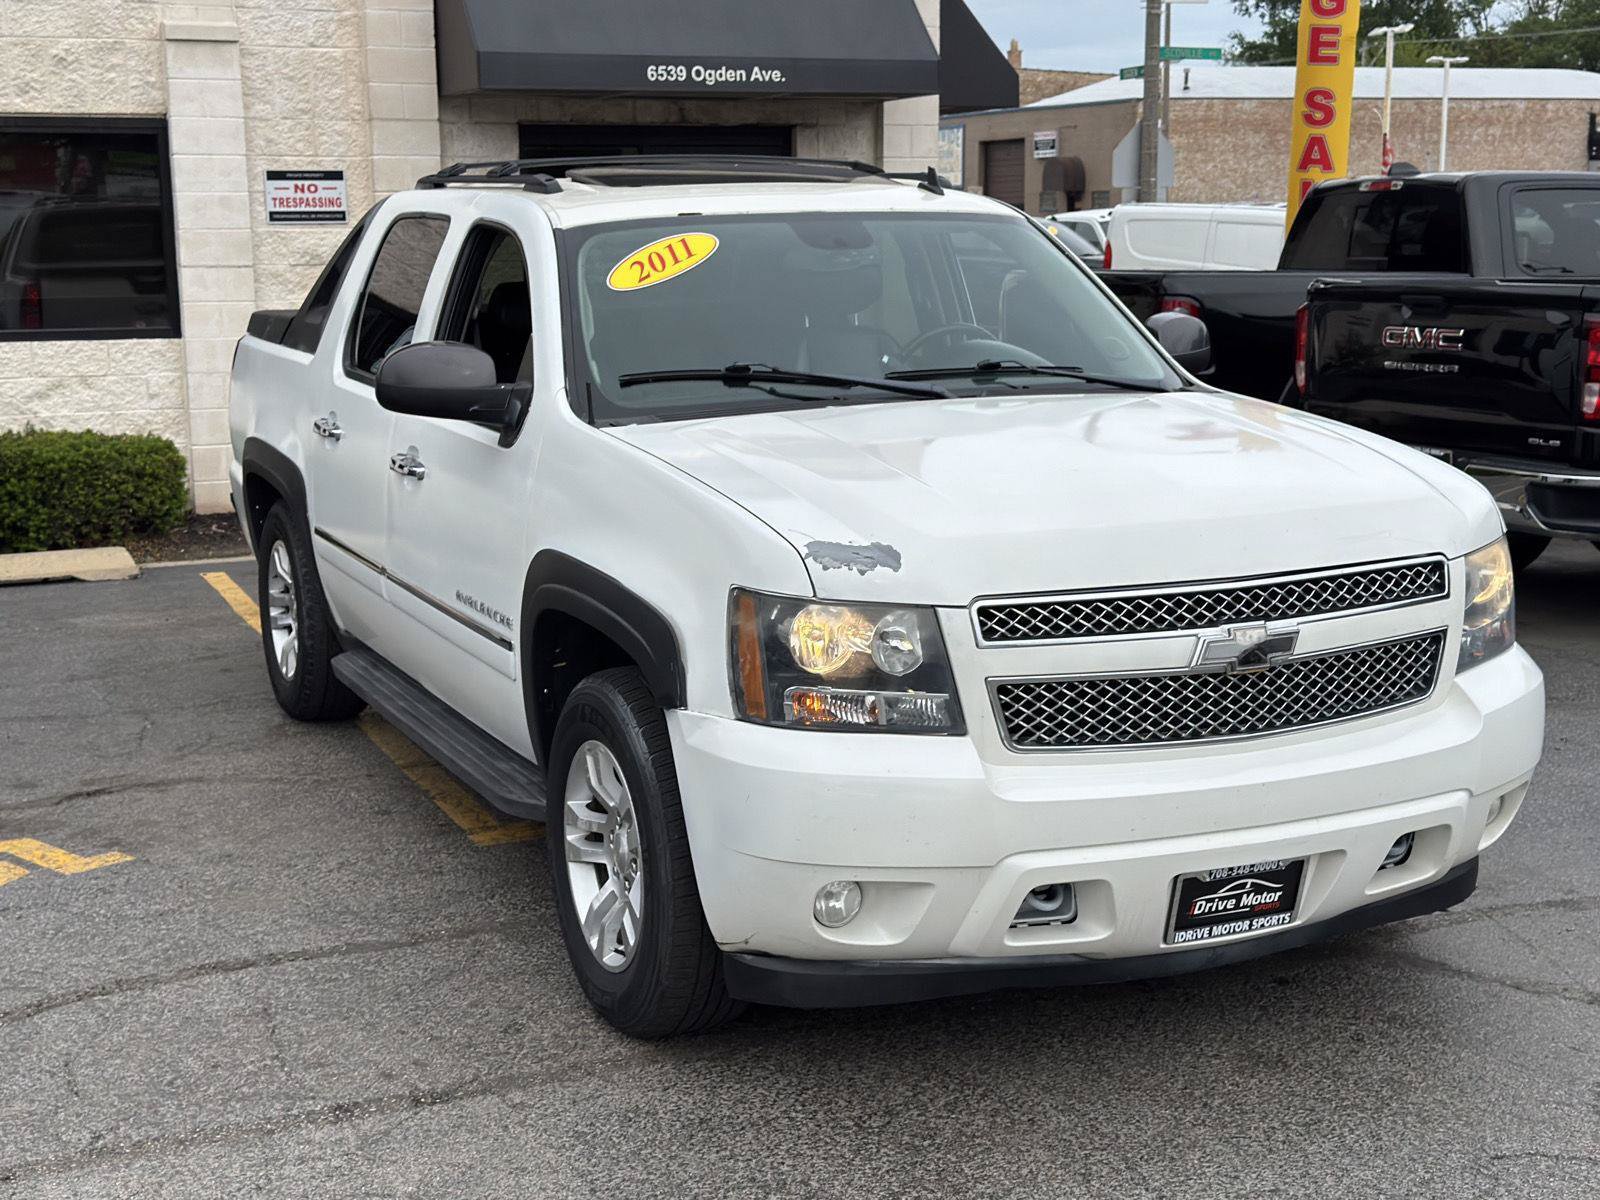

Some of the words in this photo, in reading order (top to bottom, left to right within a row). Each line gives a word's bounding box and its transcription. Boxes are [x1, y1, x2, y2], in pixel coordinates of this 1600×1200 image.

[646, 65, 687, 82] 6539
[691, 65, 746, 85] Ogden
[750, 66, 787, 82] Ave.
[1296, 87, 1336, 206] SA
[293, 183, 319, 194] NO
[271, 197, 343, 208] TRESPASSING
[629, 237, 697, 284] 2011
[1382, 326, 1465, 350] GMC
[1239, 891, 1284, 907] Motor
[1211, 920, 1250, 936] MOTOR
[1252, 913, 1291, 929] SPORTS
